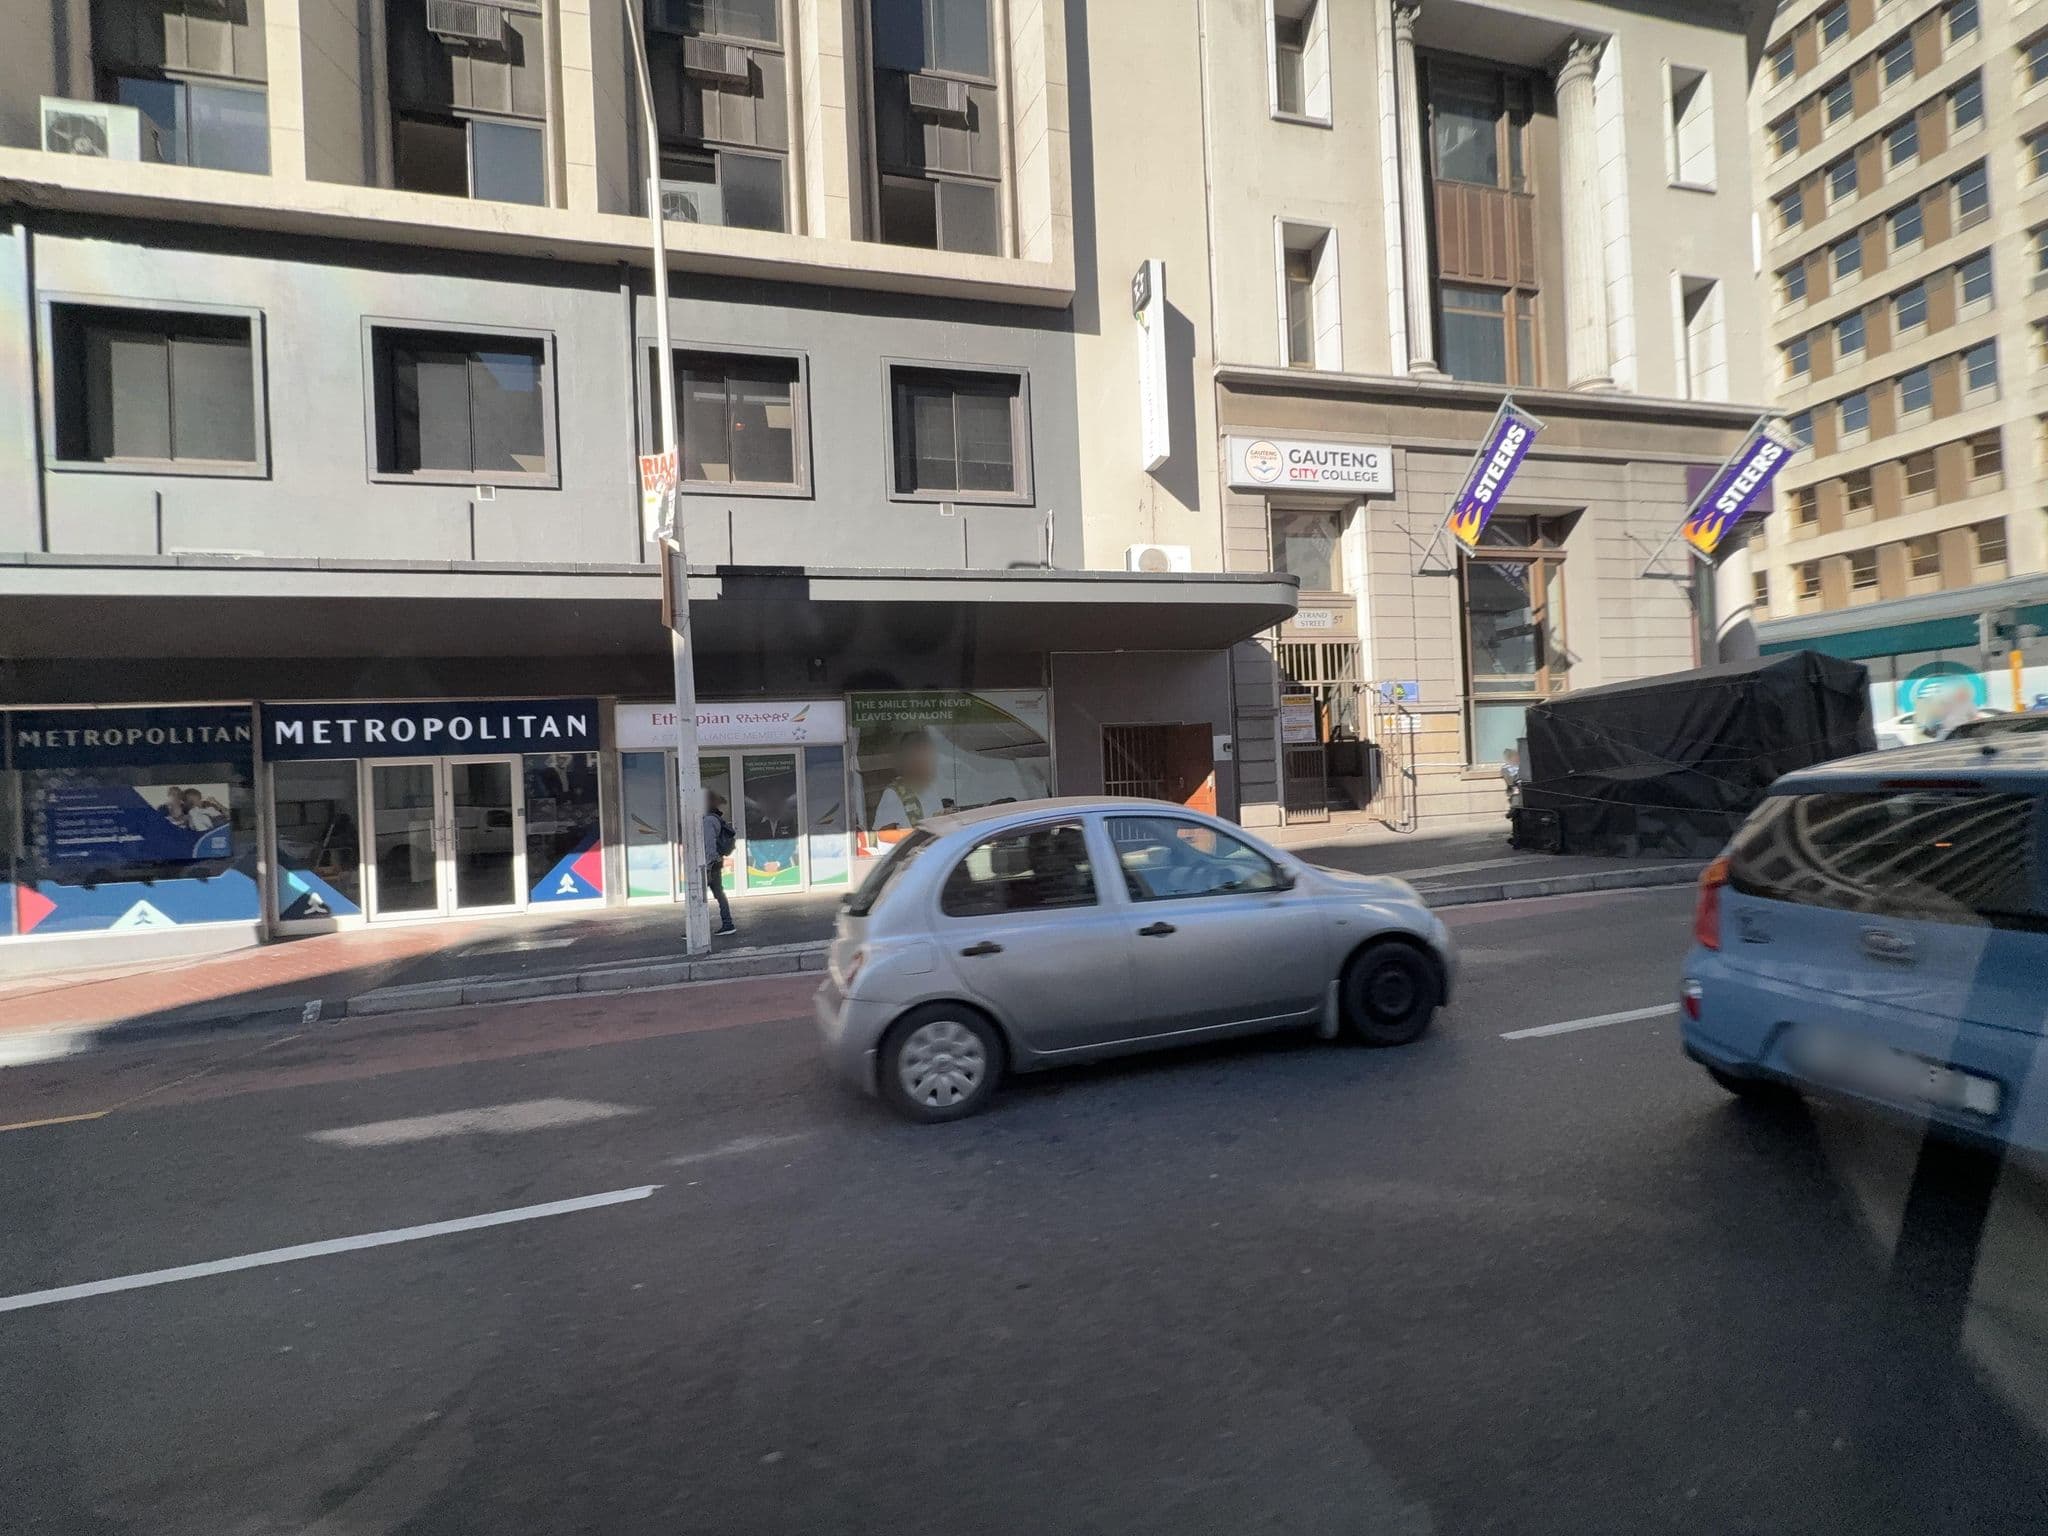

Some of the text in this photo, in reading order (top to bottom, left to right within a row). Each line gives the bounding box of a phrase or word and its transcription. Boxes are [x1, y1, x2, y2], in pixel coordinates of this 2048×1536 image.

[1288, 449, 1378, 468] GAUTENG
[1474, 424, 1527, 503] STEERS
[1289, 468, 1379, 482] CITY COLLEGE
[1716, 442, 1785, 515] STEERS
[855, 699, 972, 709] THE SMILE THAT NEVER
[652, 712, 730, 727] Ethpian
[855, 711, 953, 722] LEAVES YOU ALONE
[18, 725, 250, 747] METROPOLITAN
[275, 714, 588, 745] METROPOLITAN
